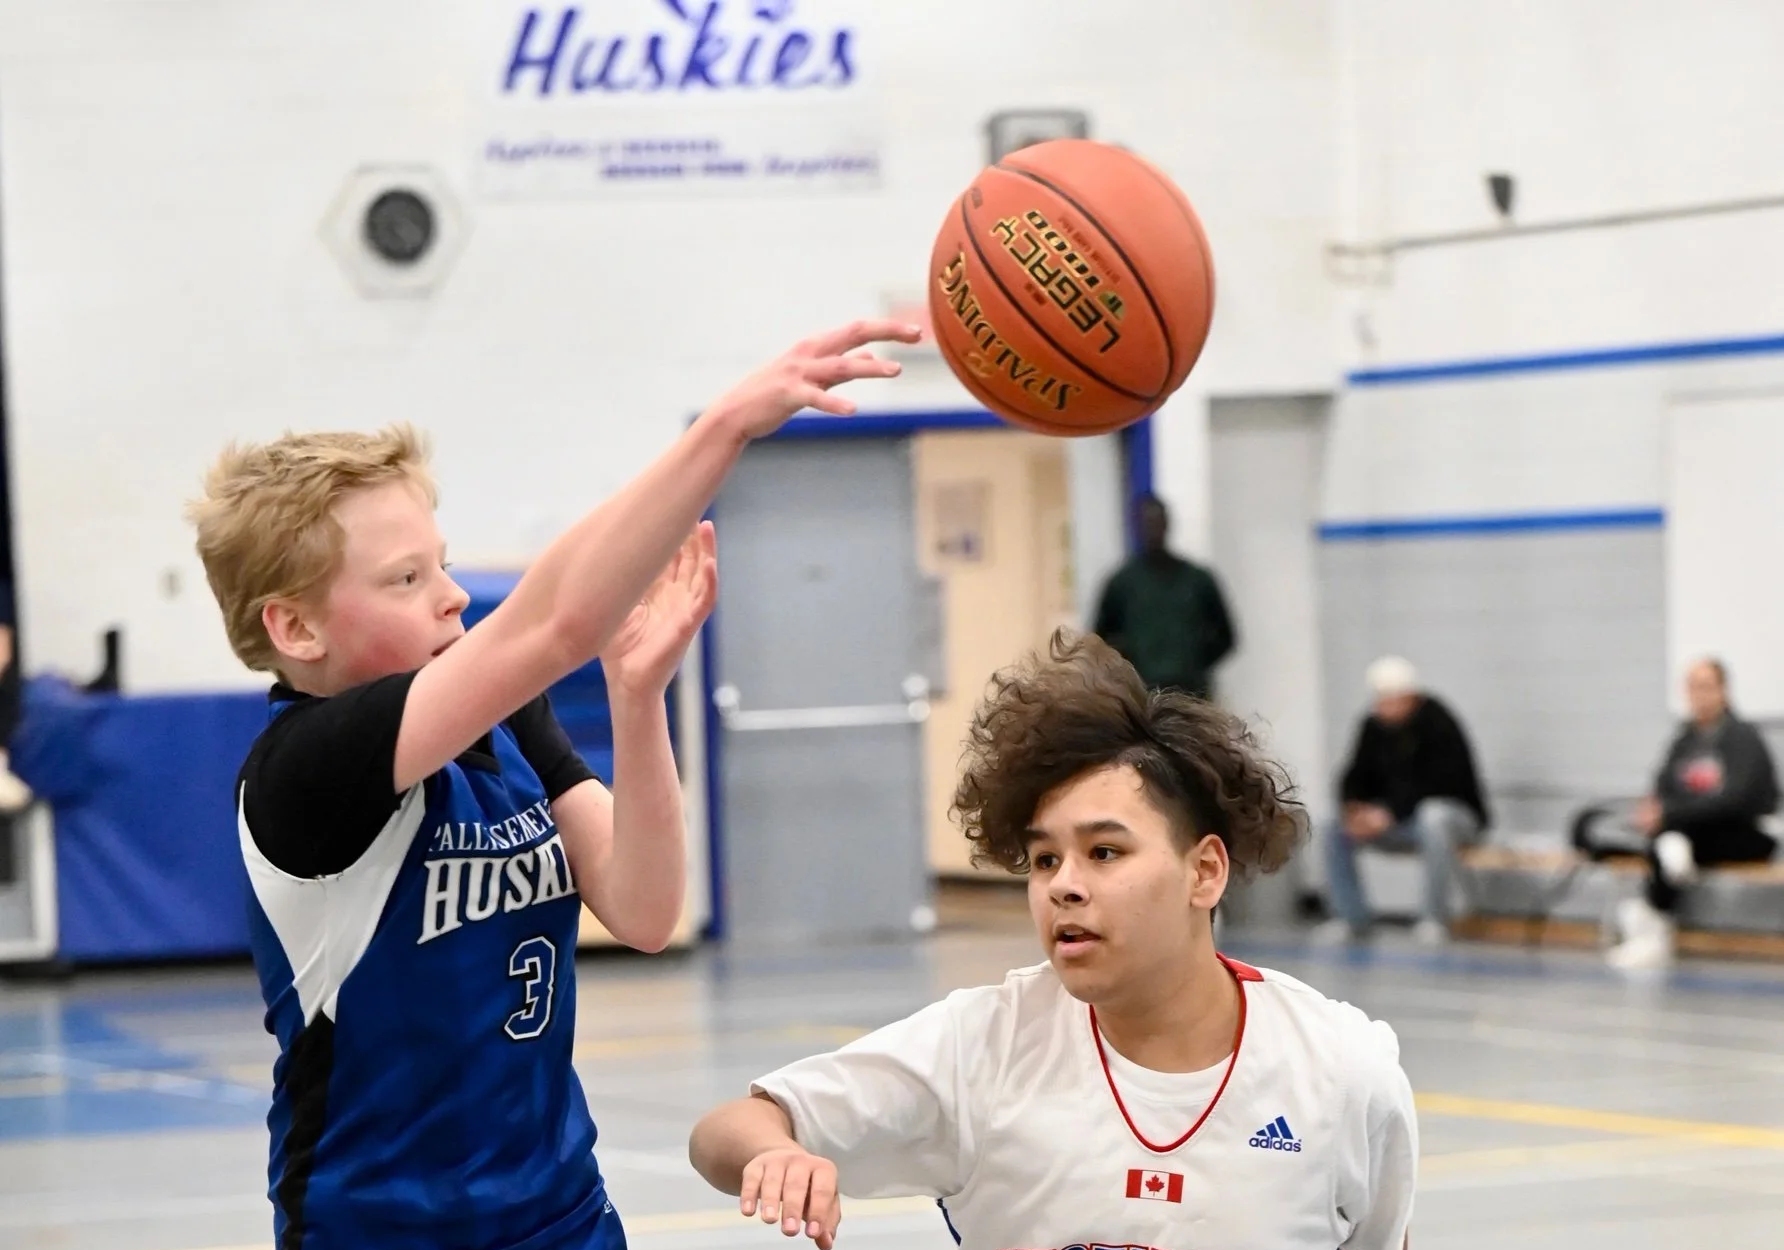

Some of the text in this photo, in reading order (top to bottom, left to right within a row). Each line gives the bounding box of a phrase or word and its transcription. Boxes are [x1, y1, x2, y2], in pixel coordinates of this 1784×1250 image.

[503, 2, 855, 94] Huskies
[990, 216, 1121, 353] LEGACY
[1023, 209, 1101, 288] 1000
[939, 252, 1082, 411] SPALDING
[504, 936, 556, 1040] 3
[1248, 1136, 1302, 1152] adidas
